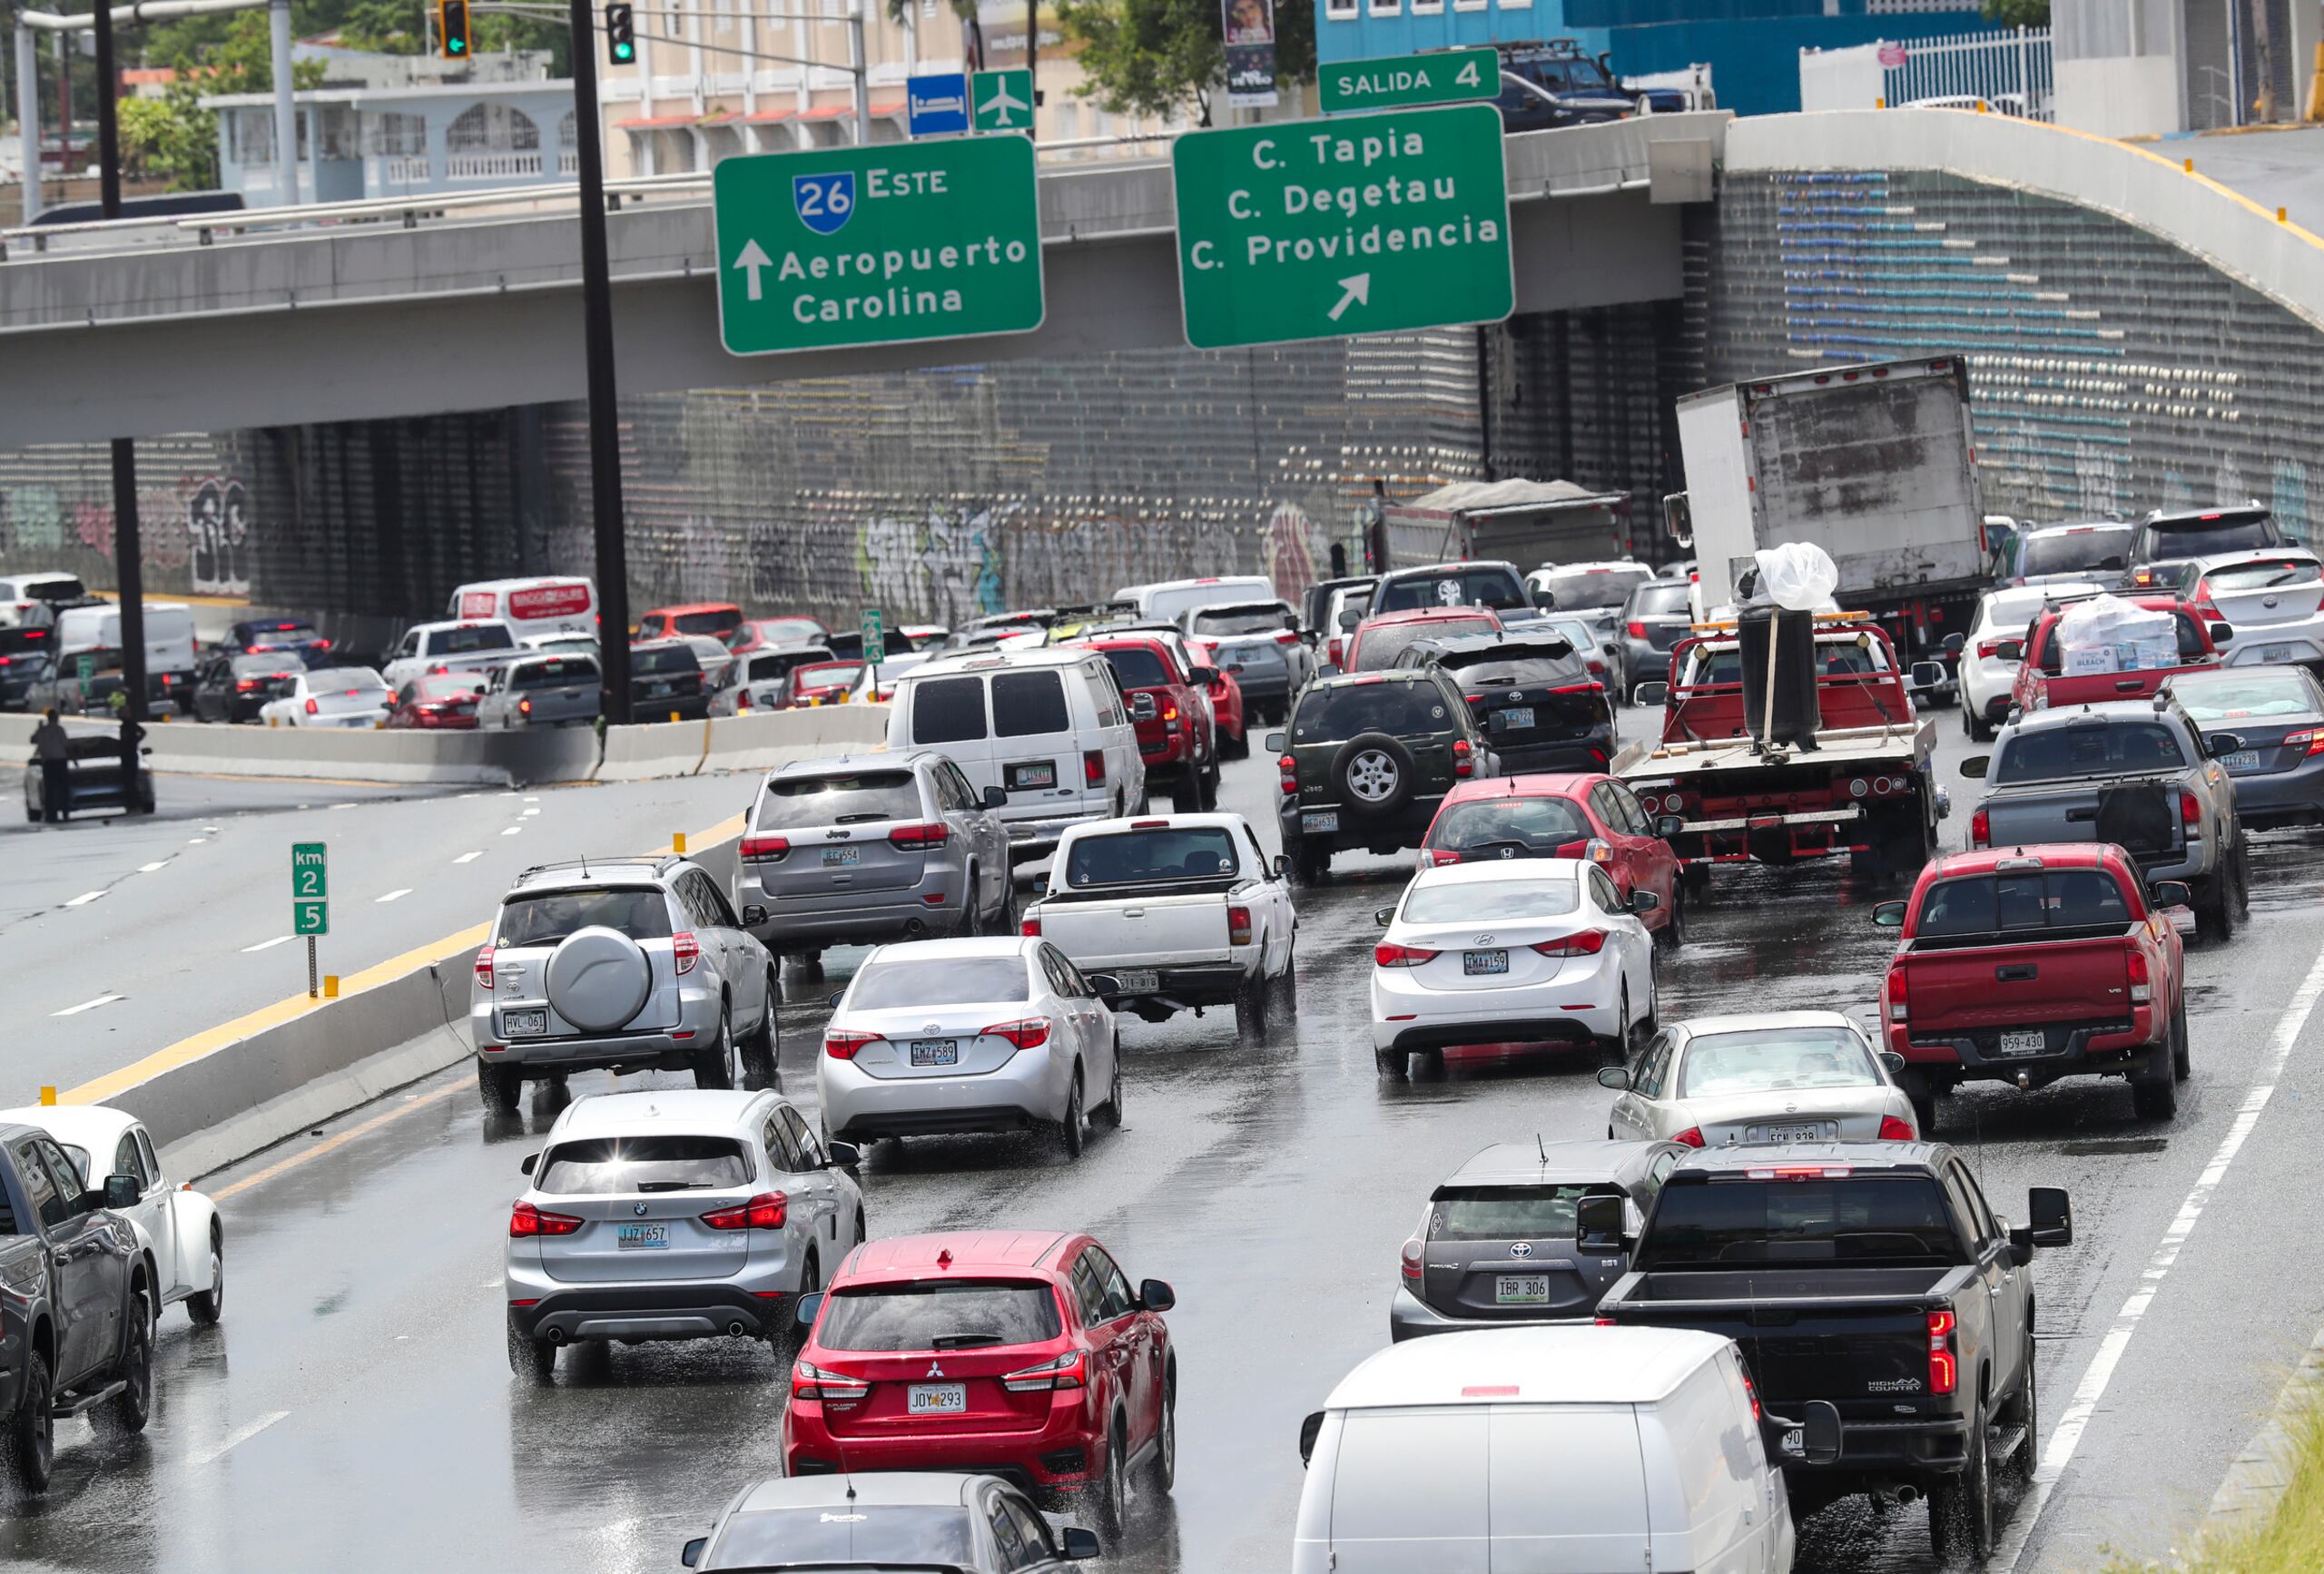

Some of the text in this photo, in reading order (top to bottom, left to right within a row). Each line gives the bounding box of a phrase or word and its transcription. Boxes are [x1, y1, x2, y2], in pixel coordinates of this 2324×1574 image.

[1337, 61, 1481, 95] SALIDA 4
[1253, 128, 1423, 170] C. Tapia
[799, 168, 948, 216] 26 ESTE
[1228, 175, 1455, 219] C. Degetau
[1191, 214, 1499, 271] C. Providencia
[778, 236, 1027, 281] Aeropuerto
[793, 286, 962, 323] Carolina
[2076, 657, 2105, 666] BLEACH
[1305, 785, 1324, 793] Jeep
[826, 830, 851, 839] Jeep
[296, 851, 322, 865] km
[301, 871, 318, 893] 2
[1489, 956, 1505, 968] 159
[507, 1015, 544, 1028] HVL 061
[2003, 1036, 2043, 1049] 959-430
[937, 1046, 954, 1058] 589
[620, 1226, 665, 1242] JJZ 657
[1499, 1282, 1545, 1295] IBR 306
[940, 1392, 960, 1406] 293
